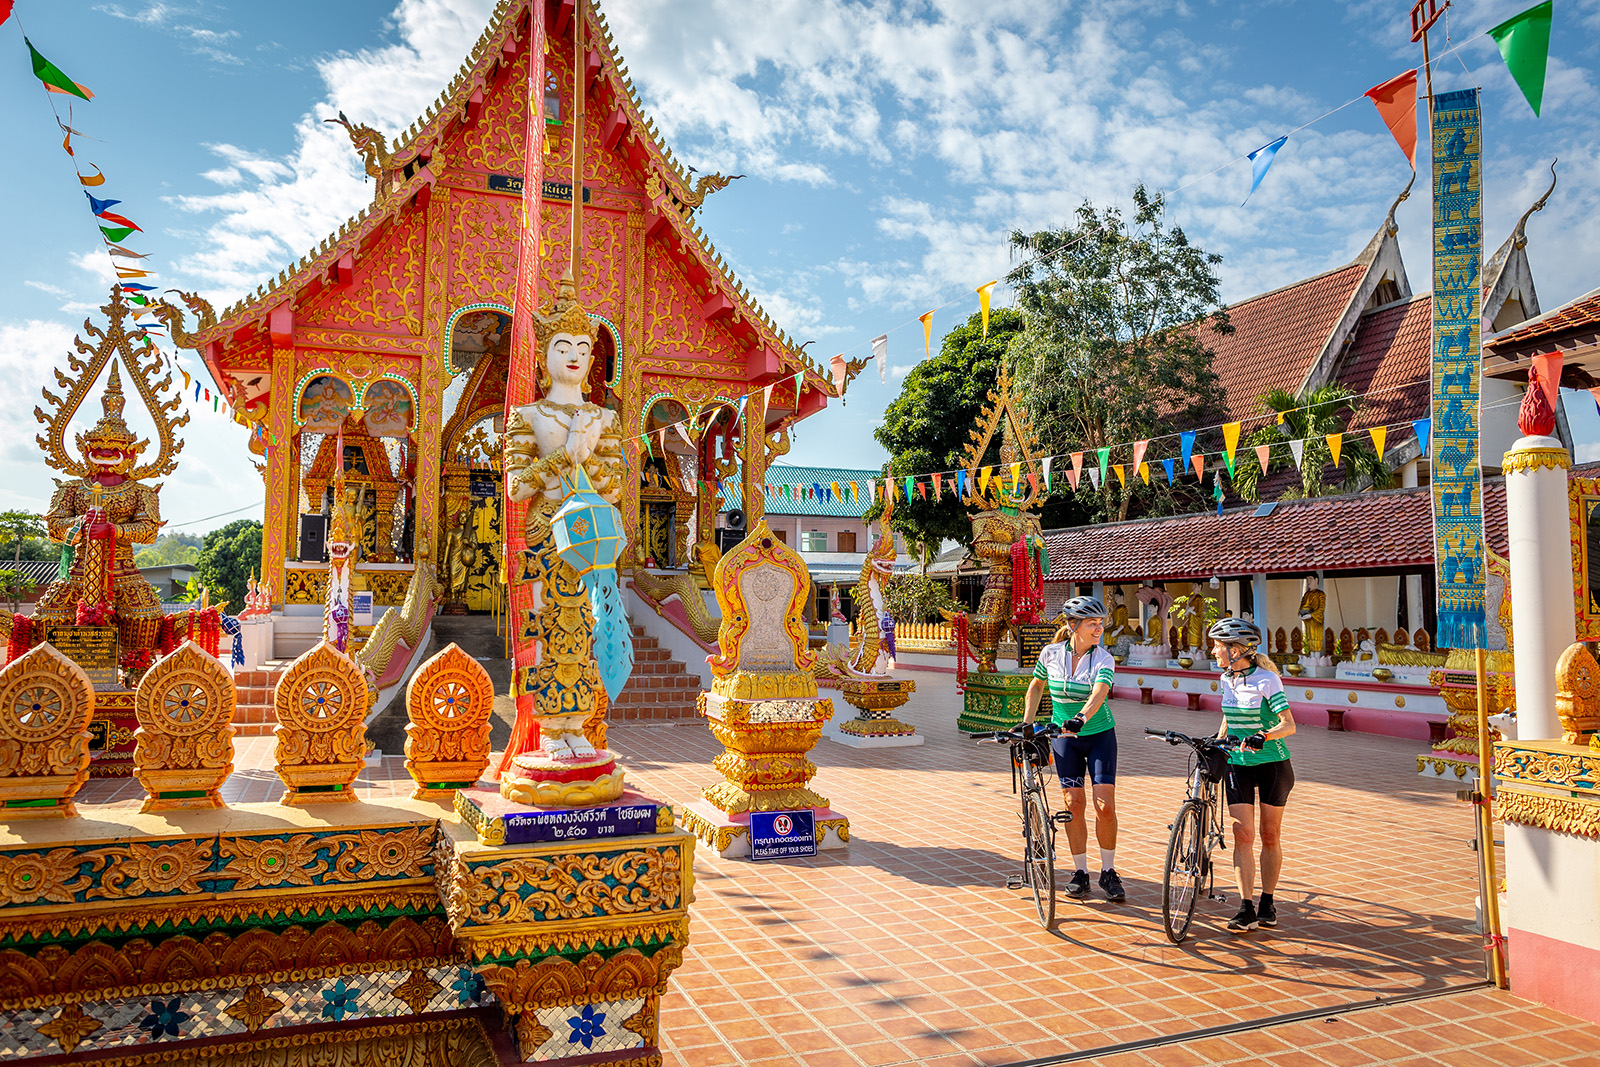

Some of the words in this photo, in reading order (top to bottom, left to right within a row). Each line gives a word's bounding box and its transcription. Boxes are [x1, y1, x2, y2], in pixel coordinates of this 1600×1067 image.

[597, 825, 615, 834] บาท
[768, 847, 779, 855] TAKE
[779, 846, 788, 854] OFF
[800, 845, 813, 853] SHOES
